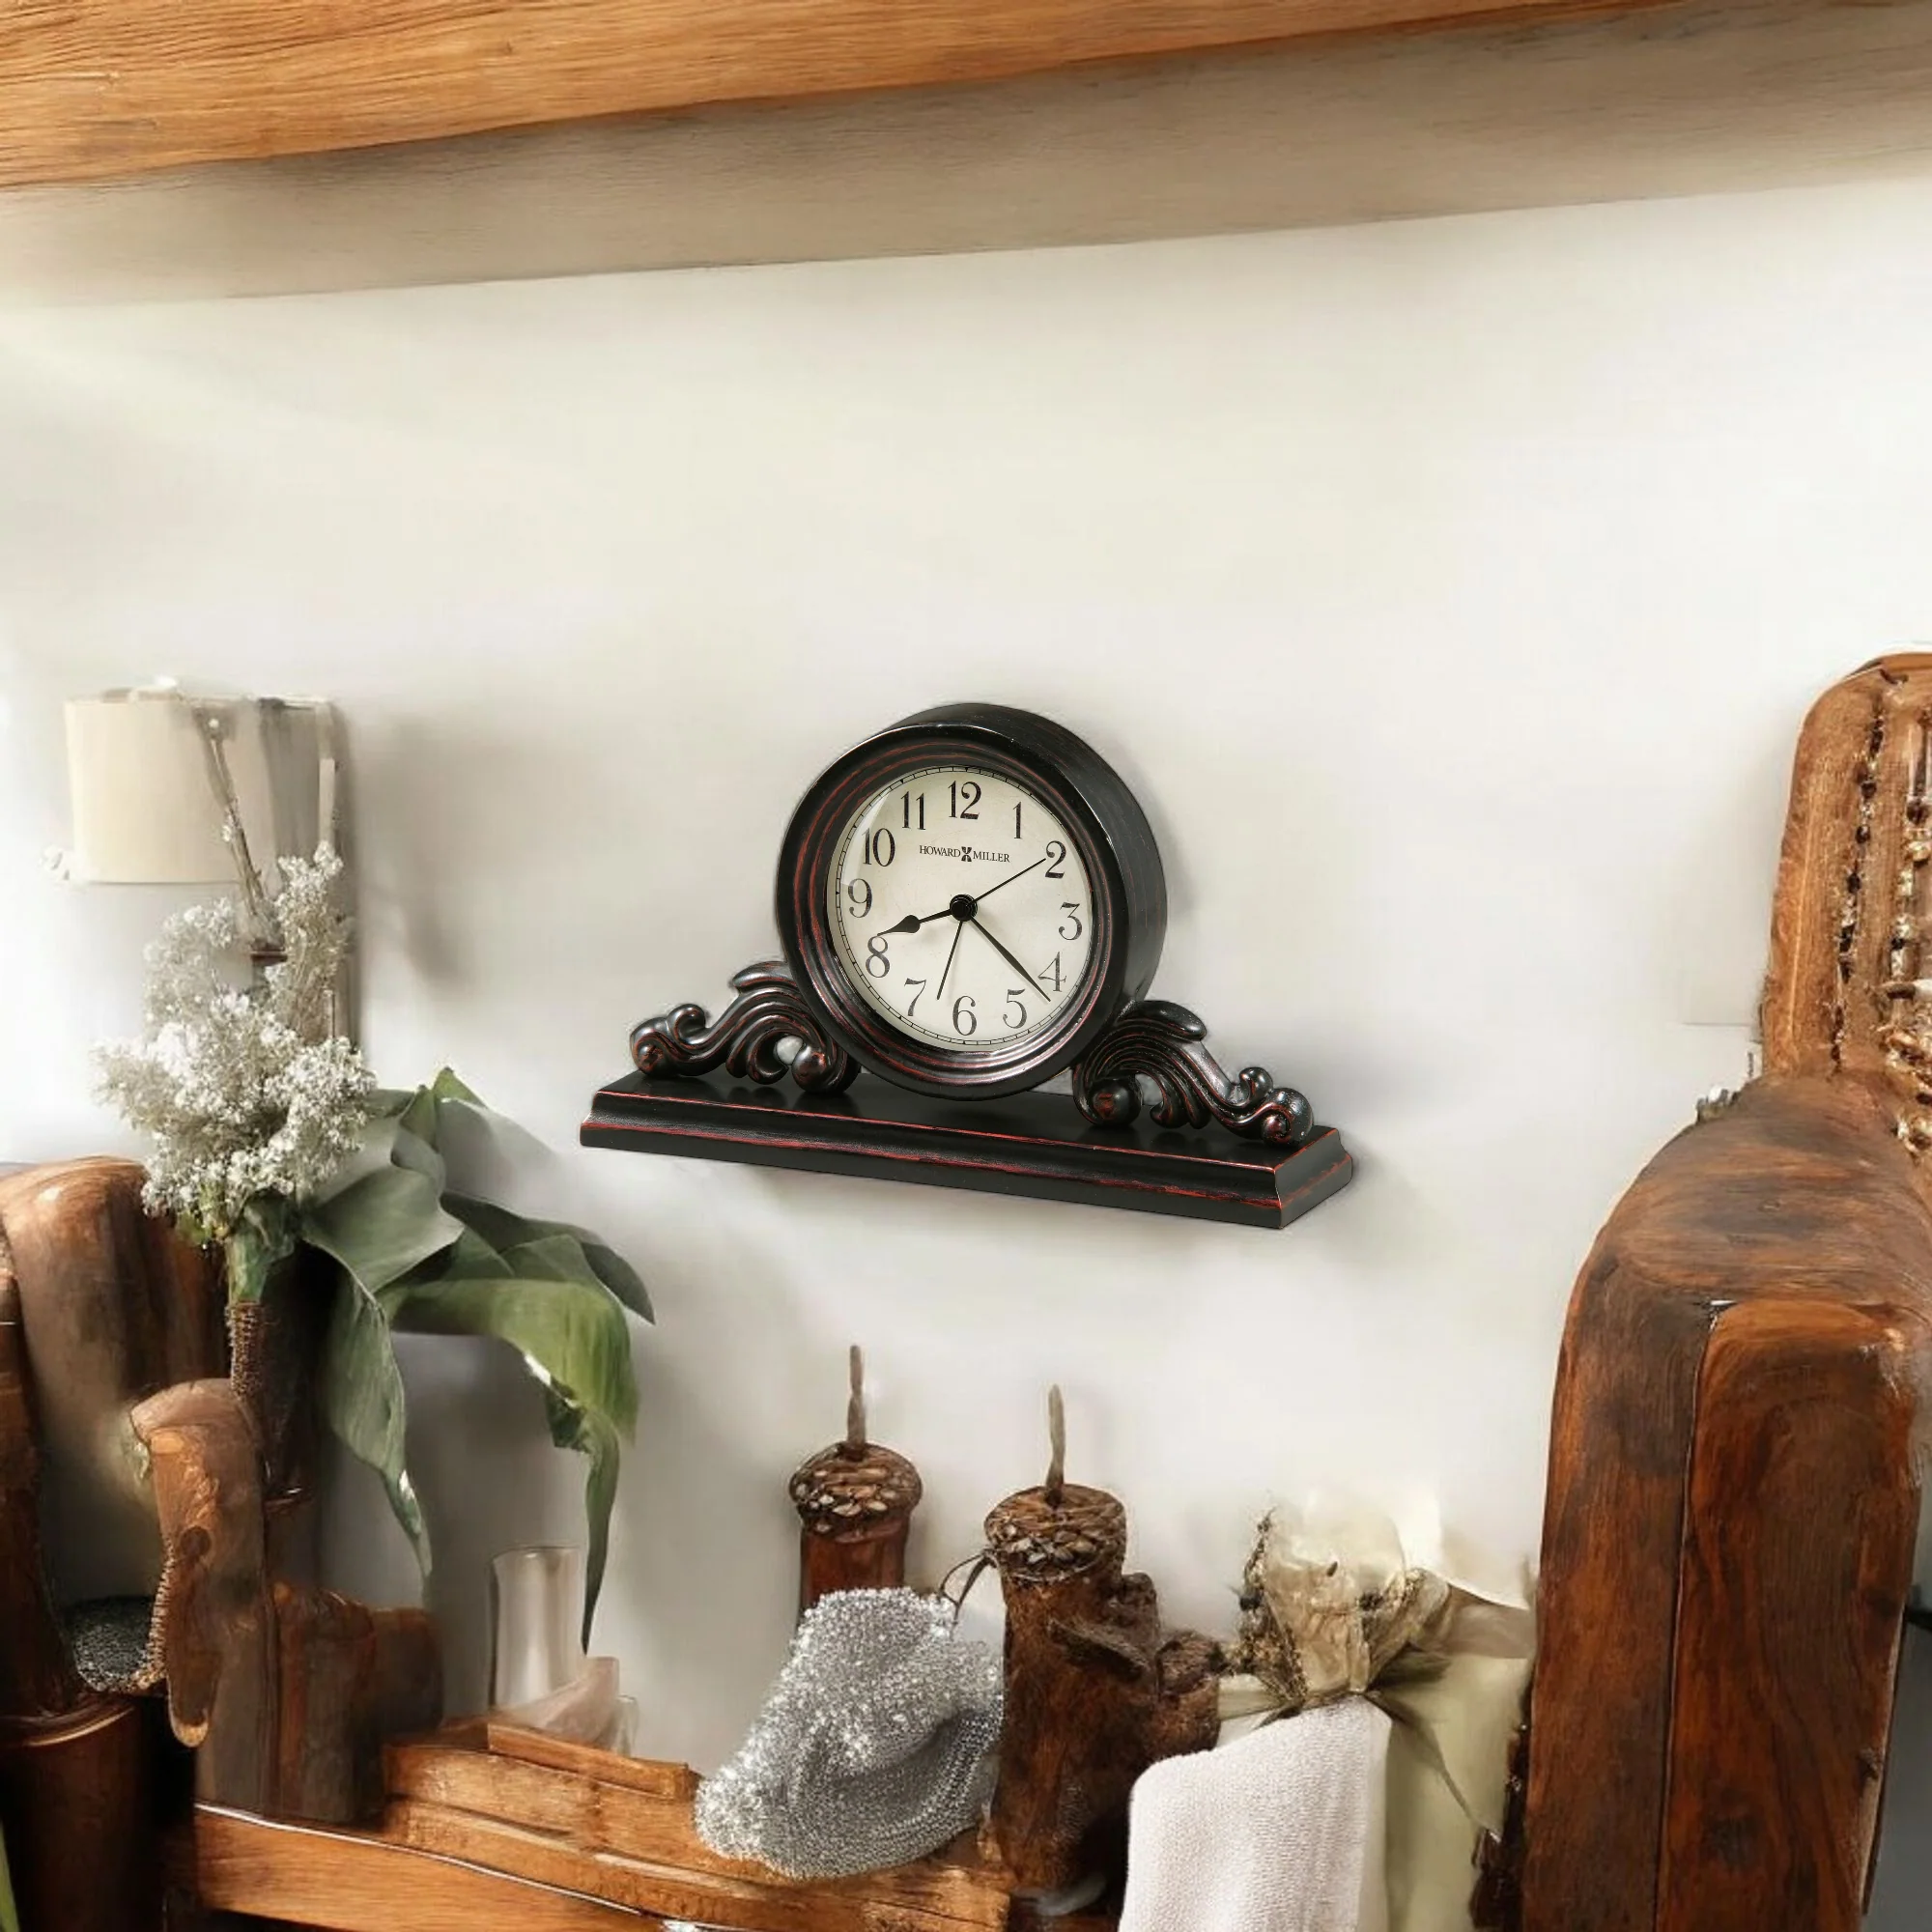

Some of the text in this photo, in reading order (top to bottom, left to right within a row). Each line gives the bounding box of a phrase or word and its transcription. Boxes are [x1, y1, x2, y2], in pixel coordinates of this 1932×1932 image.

[900, 790, 926, 831] 11
[948, 780, 981, 820] 12
[1012, 801, 1023, 839] 1
[863, 827, 895, 867] 10
[919, 844, 1010, 863] HOWARD MILLER
[1044, 839, 1066, 879] 2
[847, 878, 872, 918] 9
[1058, 901, 1083, 941] 3
[865, 934, 891, 979] 8
[1037, 952, 1066, 992] 4
[904, 978, 926, 1017] 7
[952, 995, 978, 1037] 6
[1002, 988, 1028, 1029] 5
